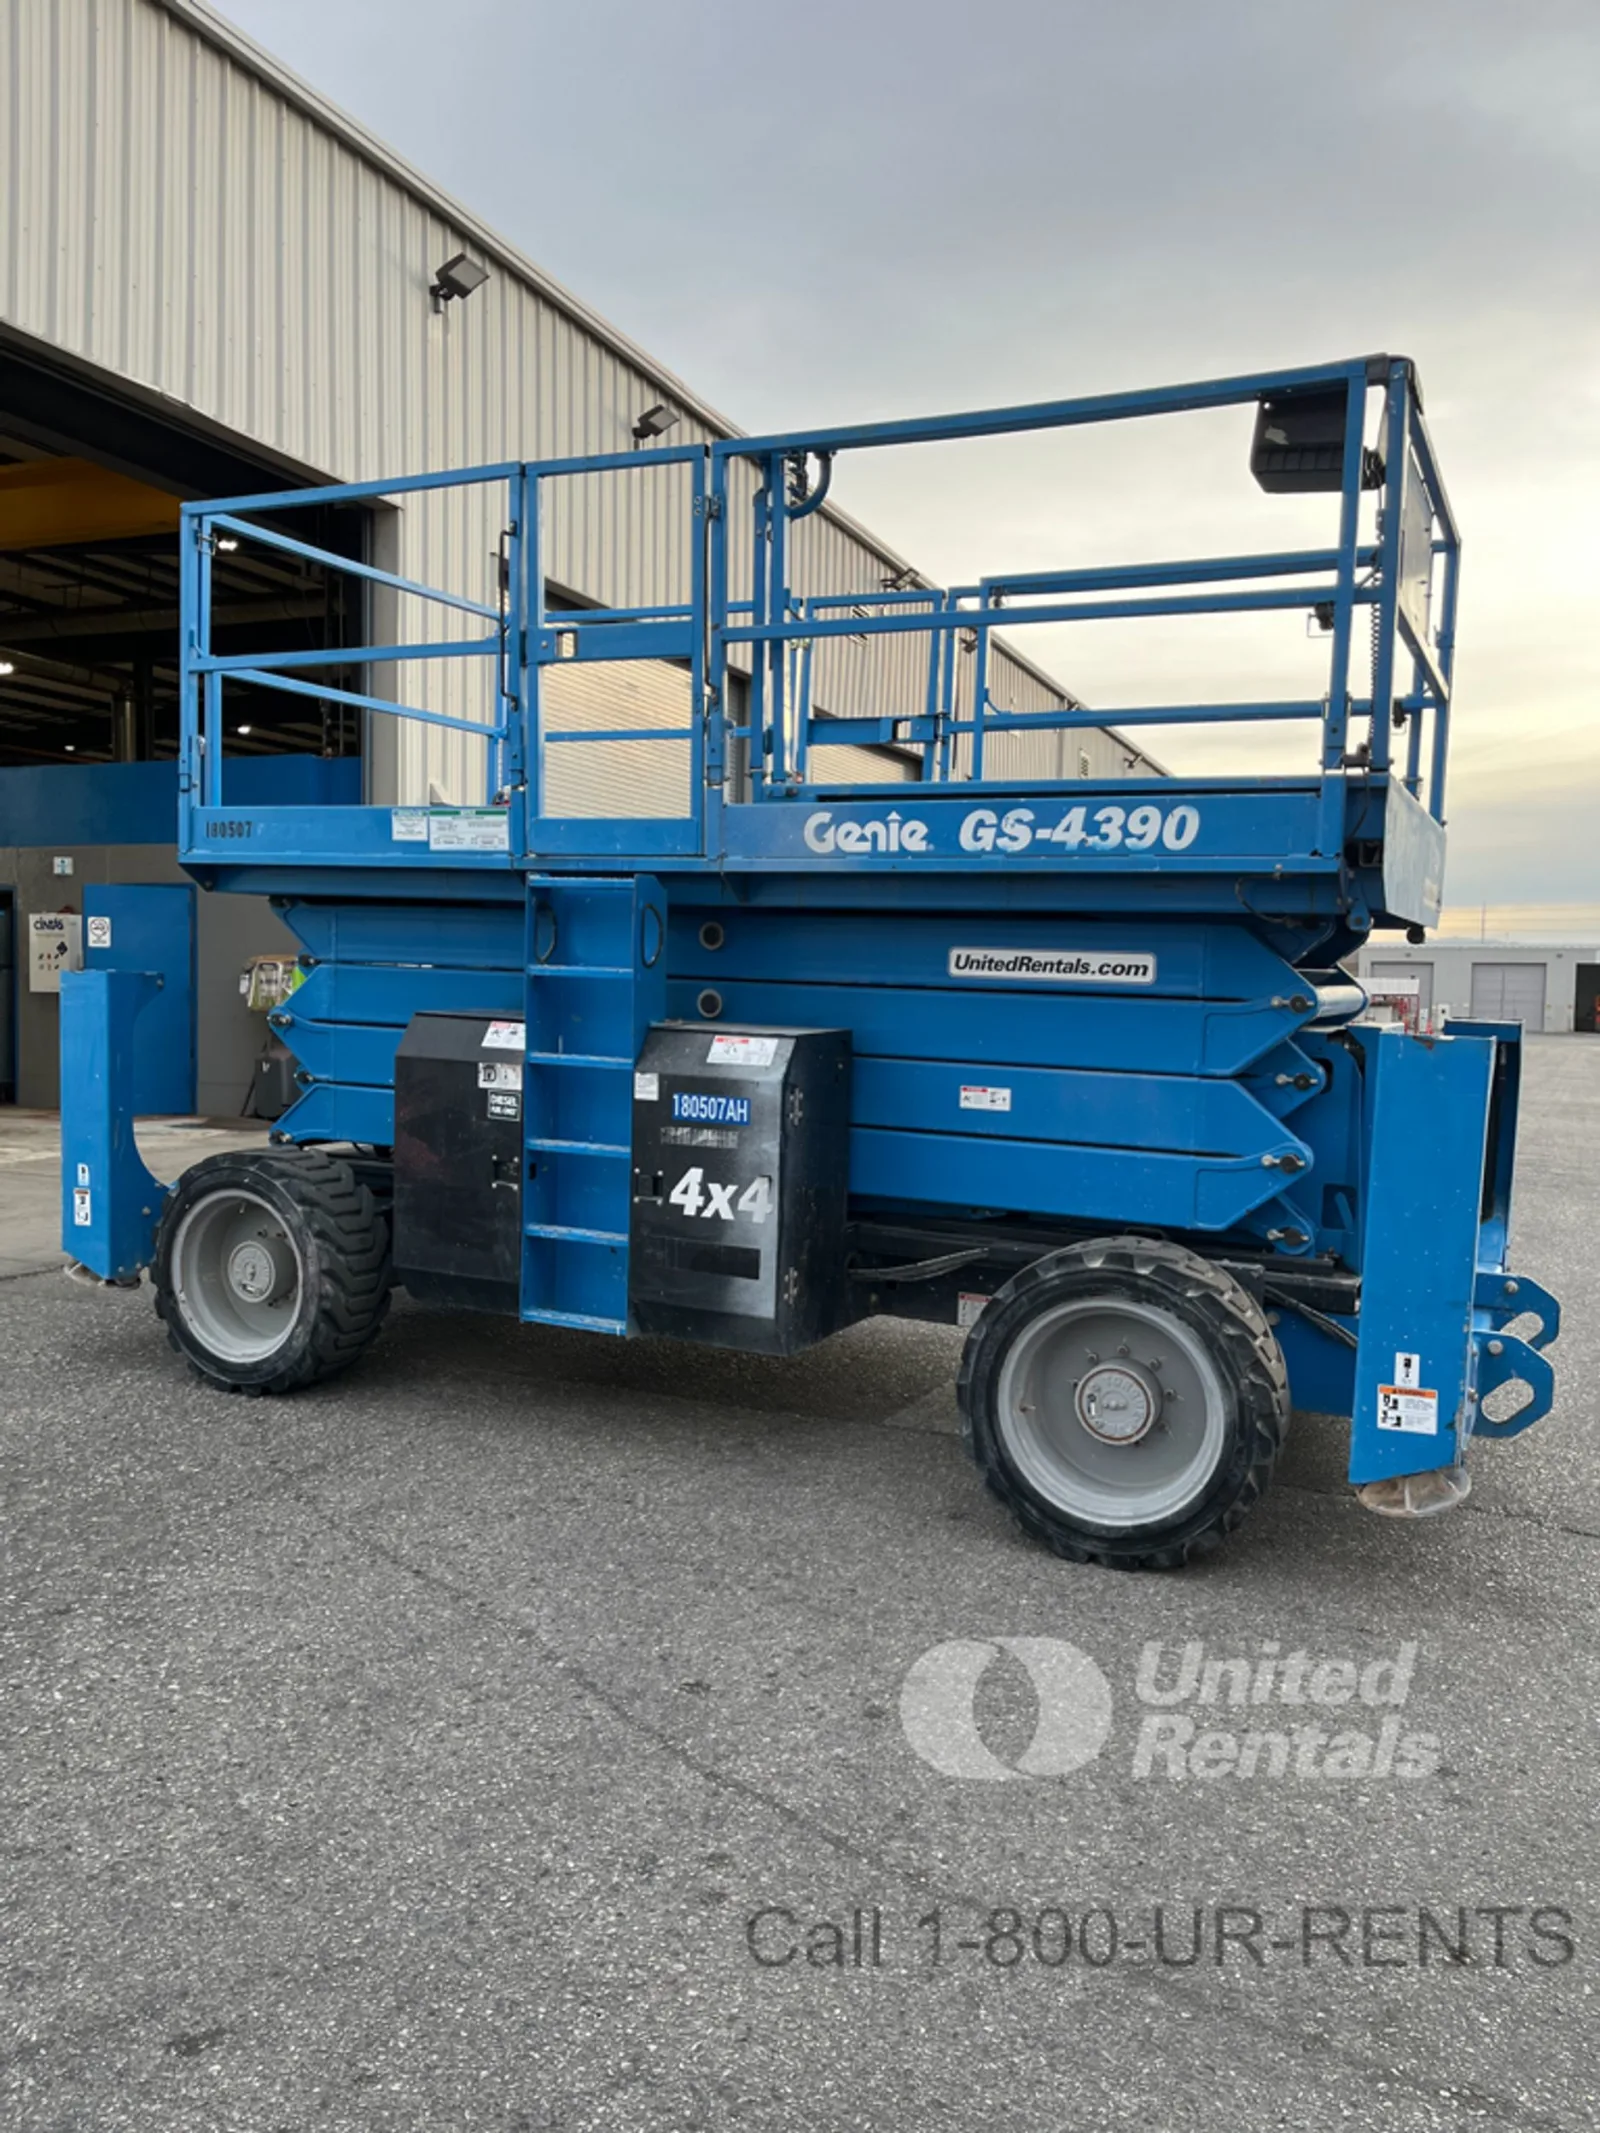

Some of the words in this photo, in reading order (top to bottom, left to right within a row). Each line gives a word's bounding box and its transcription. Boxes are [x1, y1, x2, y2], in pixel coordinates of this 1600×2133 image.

[804, 811, 929, 853] Genie
[959, 805, 1200, 852] GS-4390
[955, 953, 1149, 977] UnitedRentals.com
[672, 1094, 748, 1122] 180507AH
[669, 1166, 774, 1223] 4x4
